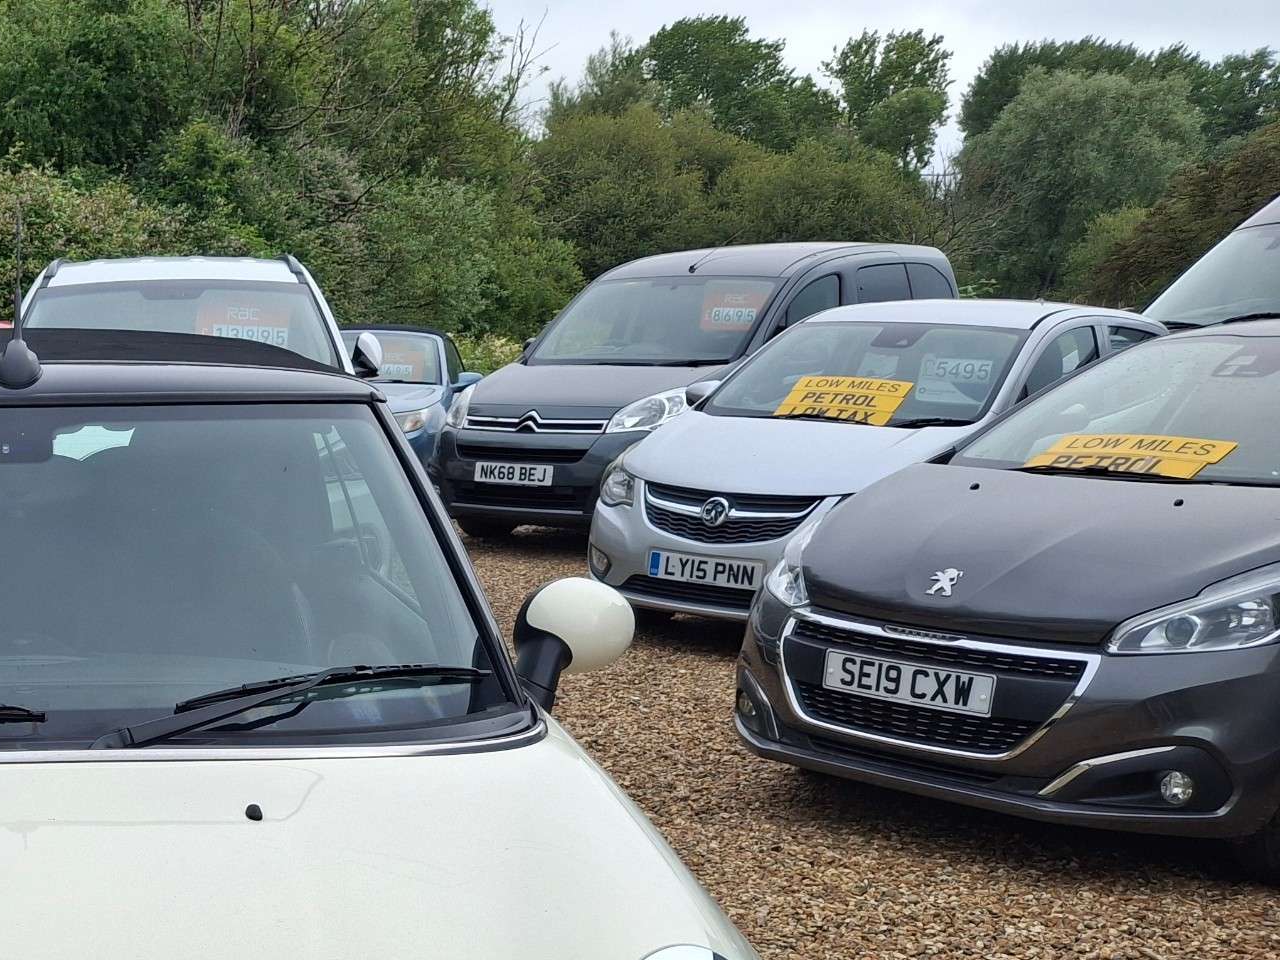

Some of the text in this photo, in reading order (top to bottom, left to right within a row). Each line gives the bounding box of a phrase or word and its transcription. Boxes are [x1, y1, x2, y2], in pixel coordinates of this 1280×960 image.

[804, 378, 902, 393] LOW MILES
[799, 391, 877, 408] PETROL
[1067, 437, 1217, 457] LOW MILES
[480, 464, 547, 482] NK68 BEJ
[663, 556, 755, 586] LY15 PNN
[840, 657, 974, 707] SE19 CXW
